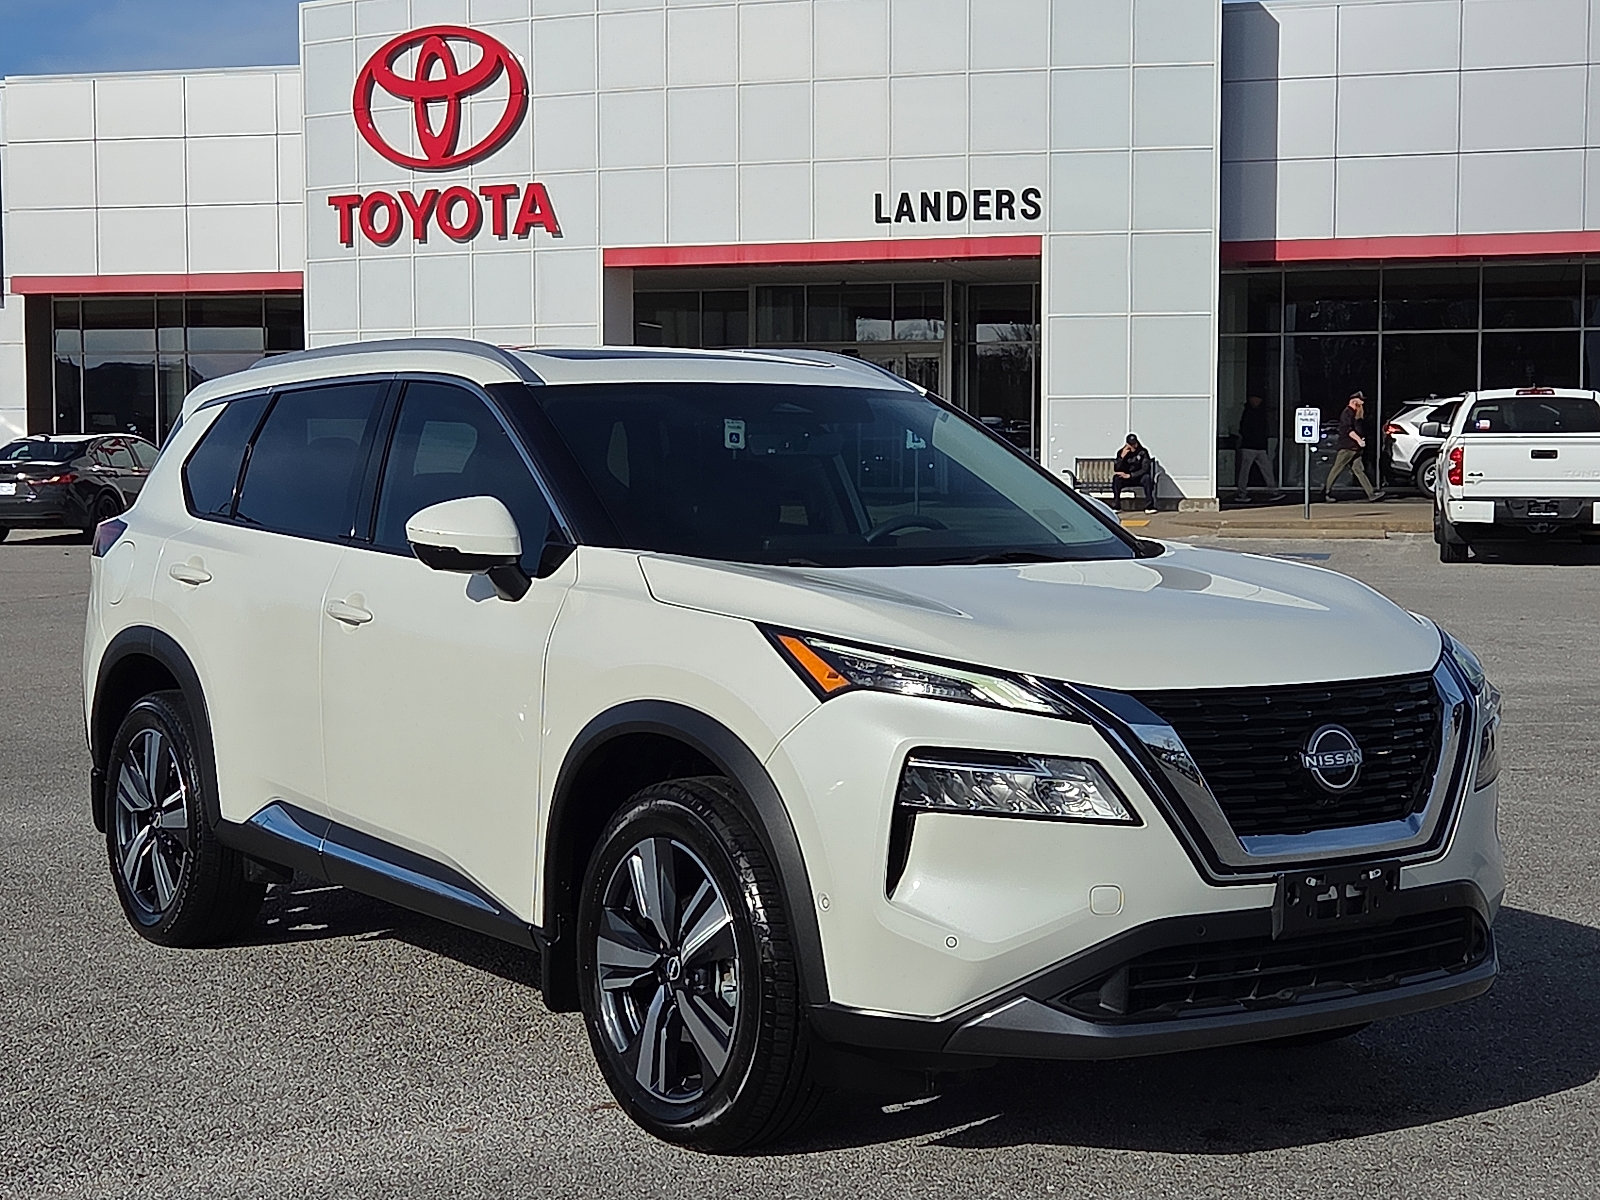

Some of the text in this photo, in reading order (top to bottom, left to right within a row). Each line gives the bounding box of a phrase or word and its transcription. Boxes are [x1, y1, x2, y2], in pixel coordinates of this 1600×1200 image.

[328, 183, 563, 247] TOYOTA
[874, 188, 1042, 224] LANDERS
[1305, 753, 1362, 767] NISSAN
